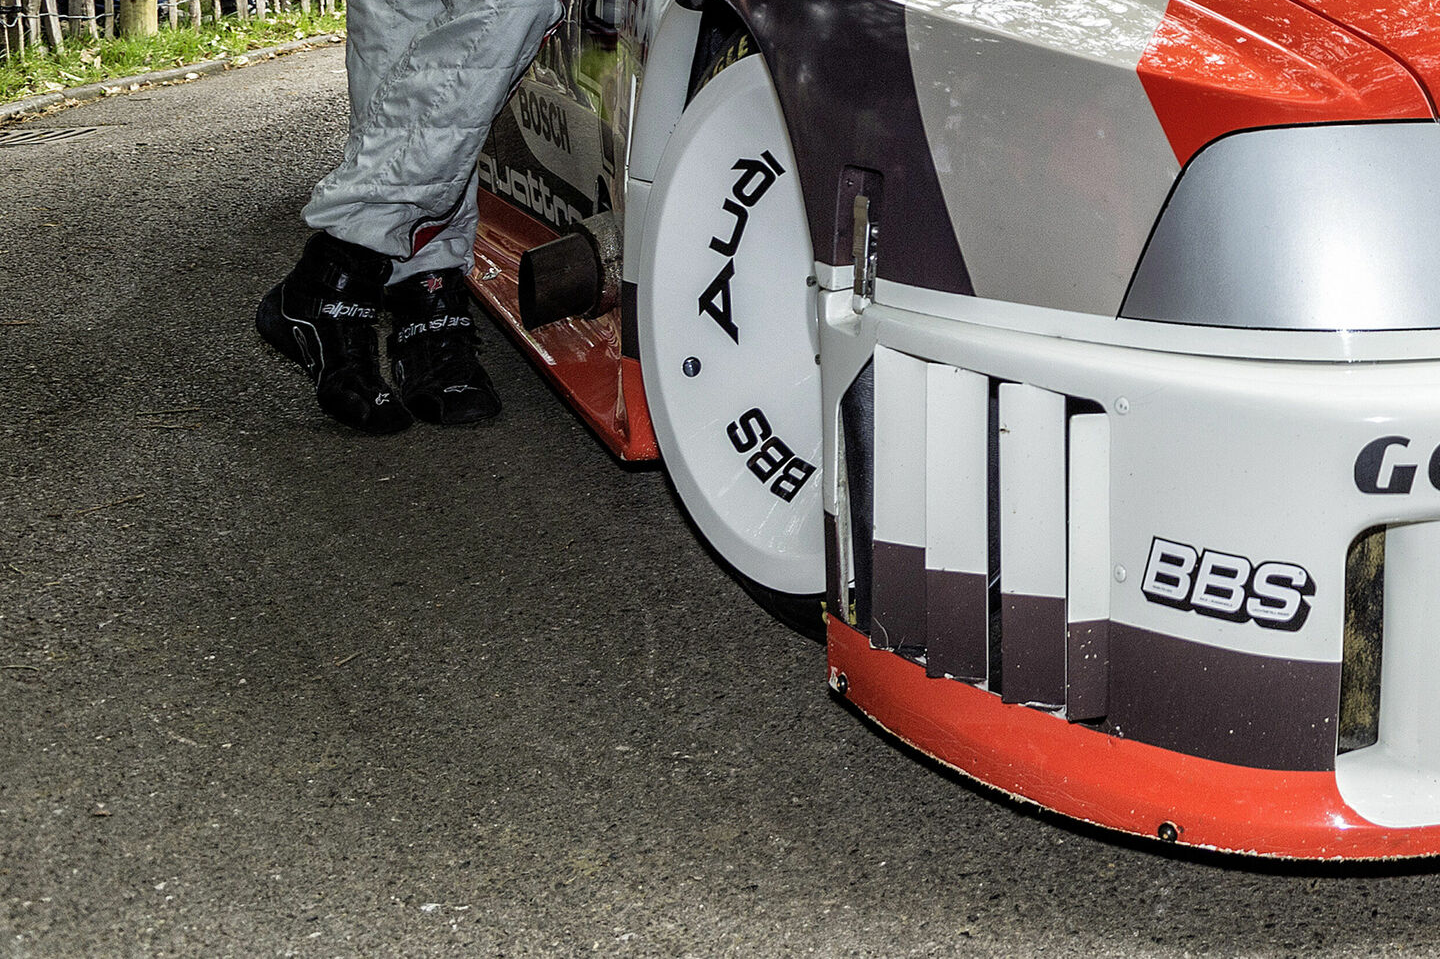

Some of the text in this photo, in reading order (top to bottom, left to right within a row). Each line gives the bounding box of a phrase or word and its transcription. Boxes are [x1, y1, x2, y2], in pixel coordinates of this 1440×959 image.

[518, 87, 571, 154] BOSCH
[698, 149, 786, 346] Audi
[726, 407, 818, 504] BBS
[1140, 535, 1317, 632] BBS
